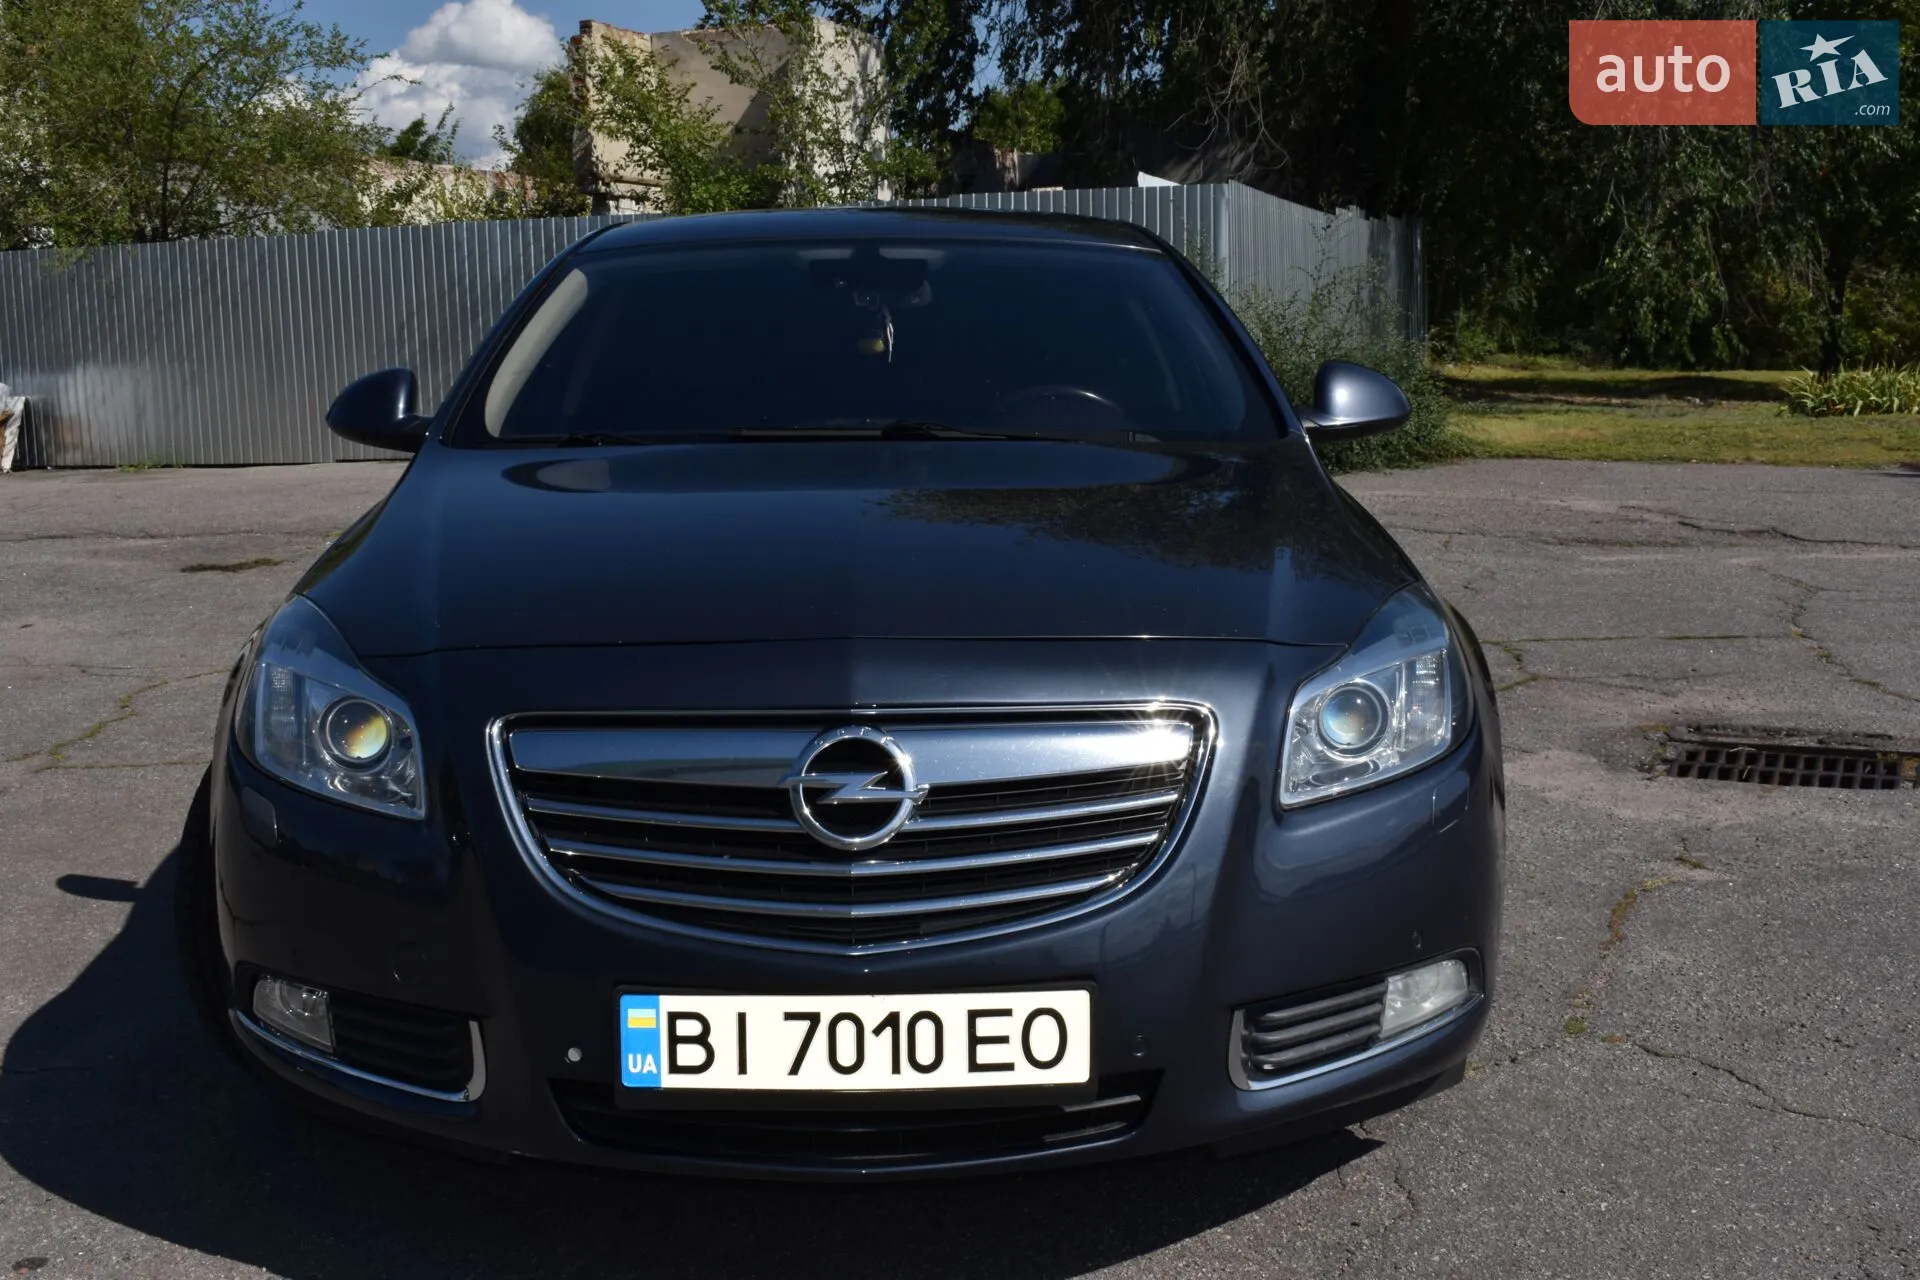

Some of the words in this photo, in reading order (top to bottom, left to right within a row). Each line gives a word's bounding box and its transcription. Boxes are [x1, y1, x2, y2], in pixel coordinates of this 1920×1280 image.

[628, 1054, 657, 1074] UA
[667, 1011, 748, 1076] BI
[783, 1010, 944, 1076] 7010
[967, 1008, 1068, 1073] EO
